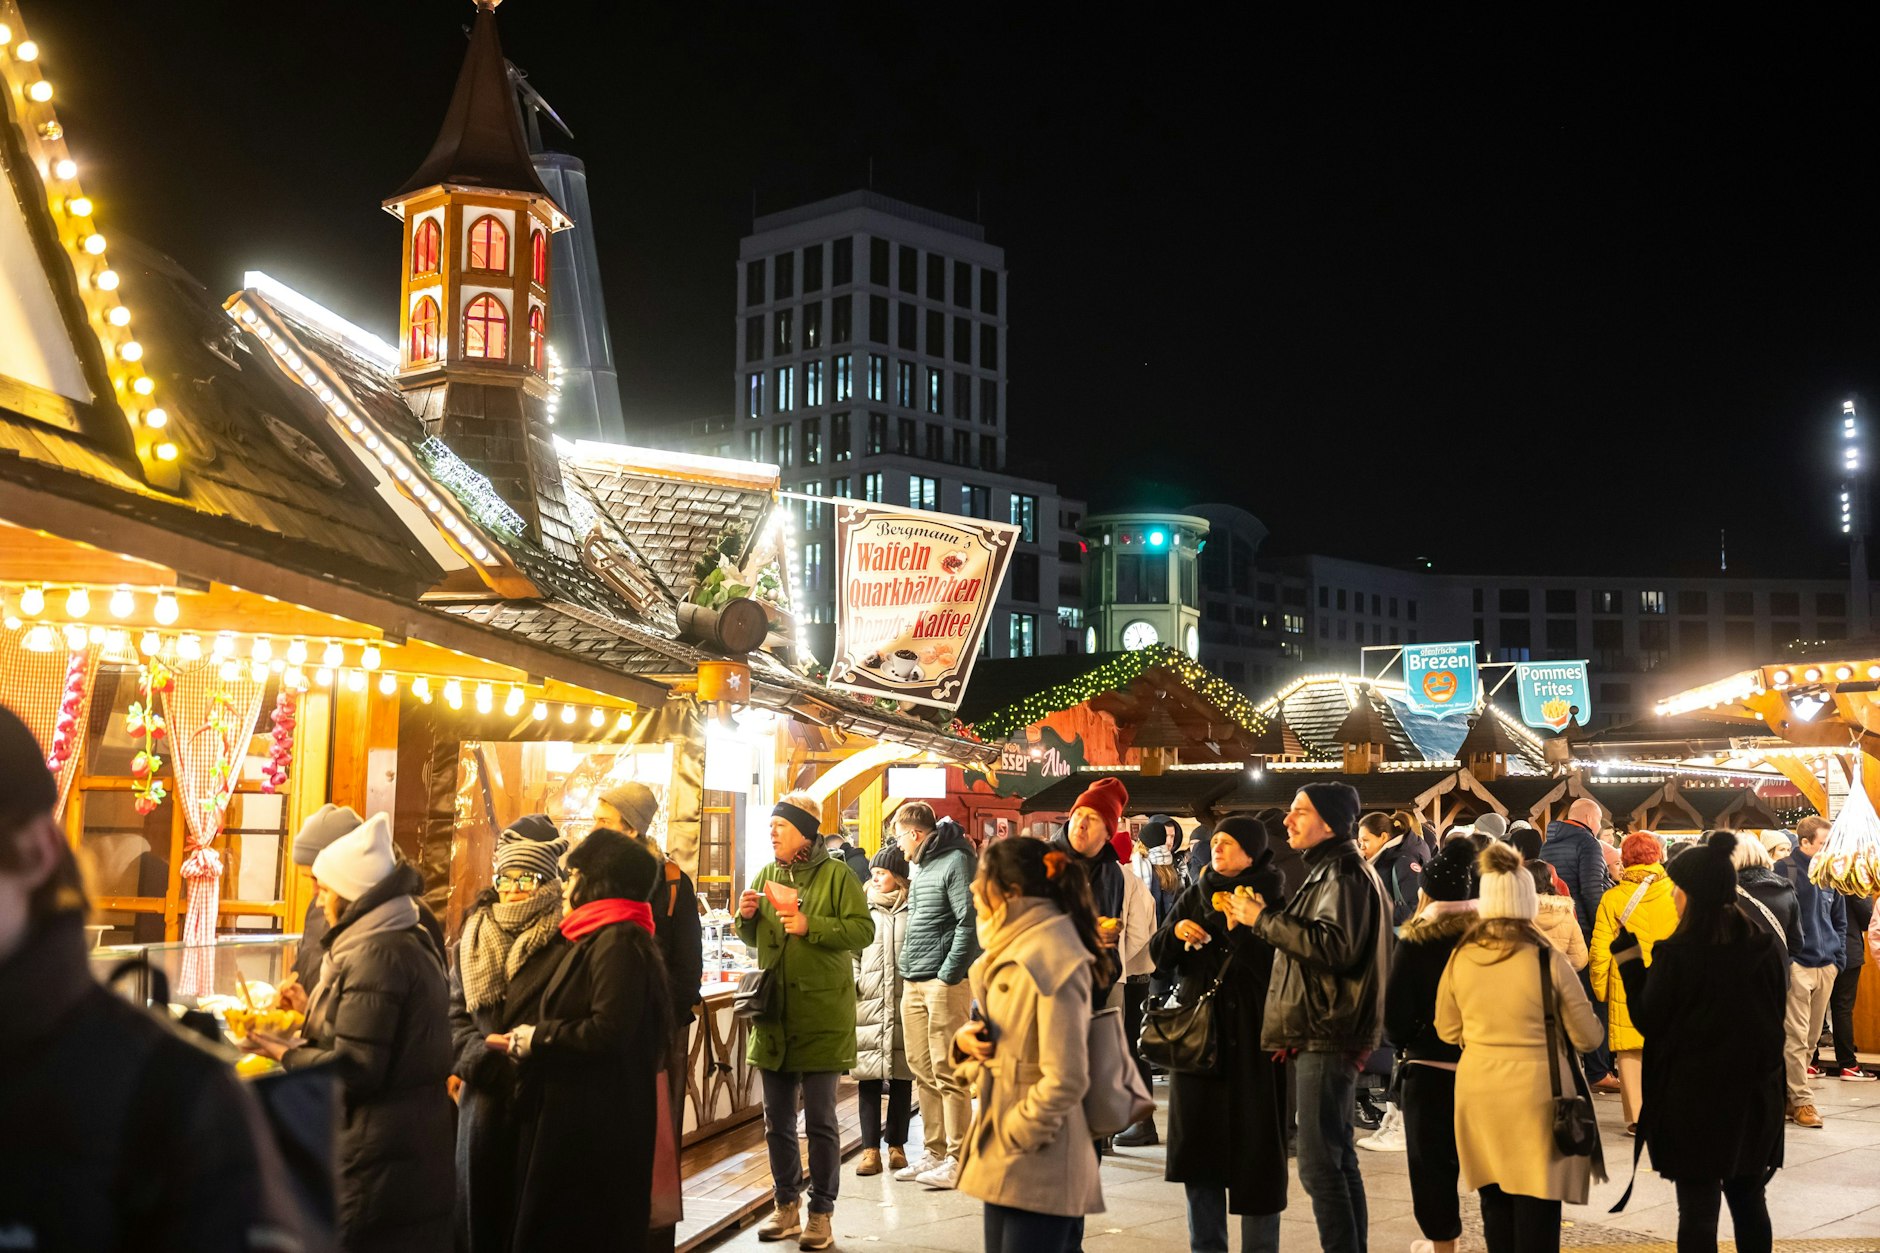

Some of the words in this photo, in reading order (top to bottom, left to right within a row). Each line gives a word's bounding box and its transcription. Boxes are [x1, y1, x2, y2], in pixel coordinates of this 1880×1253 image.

[857, 542, 931, 572] Waffeln
[849, 575, 982, 610] Quarkbällchen
[912, 609, 971, 640] Kaffee
[1409, 654, 1469, 670] Brezen
[1522, 666, 1582, 681] Pommes
[1534, 682, 1574, 697] Frites
